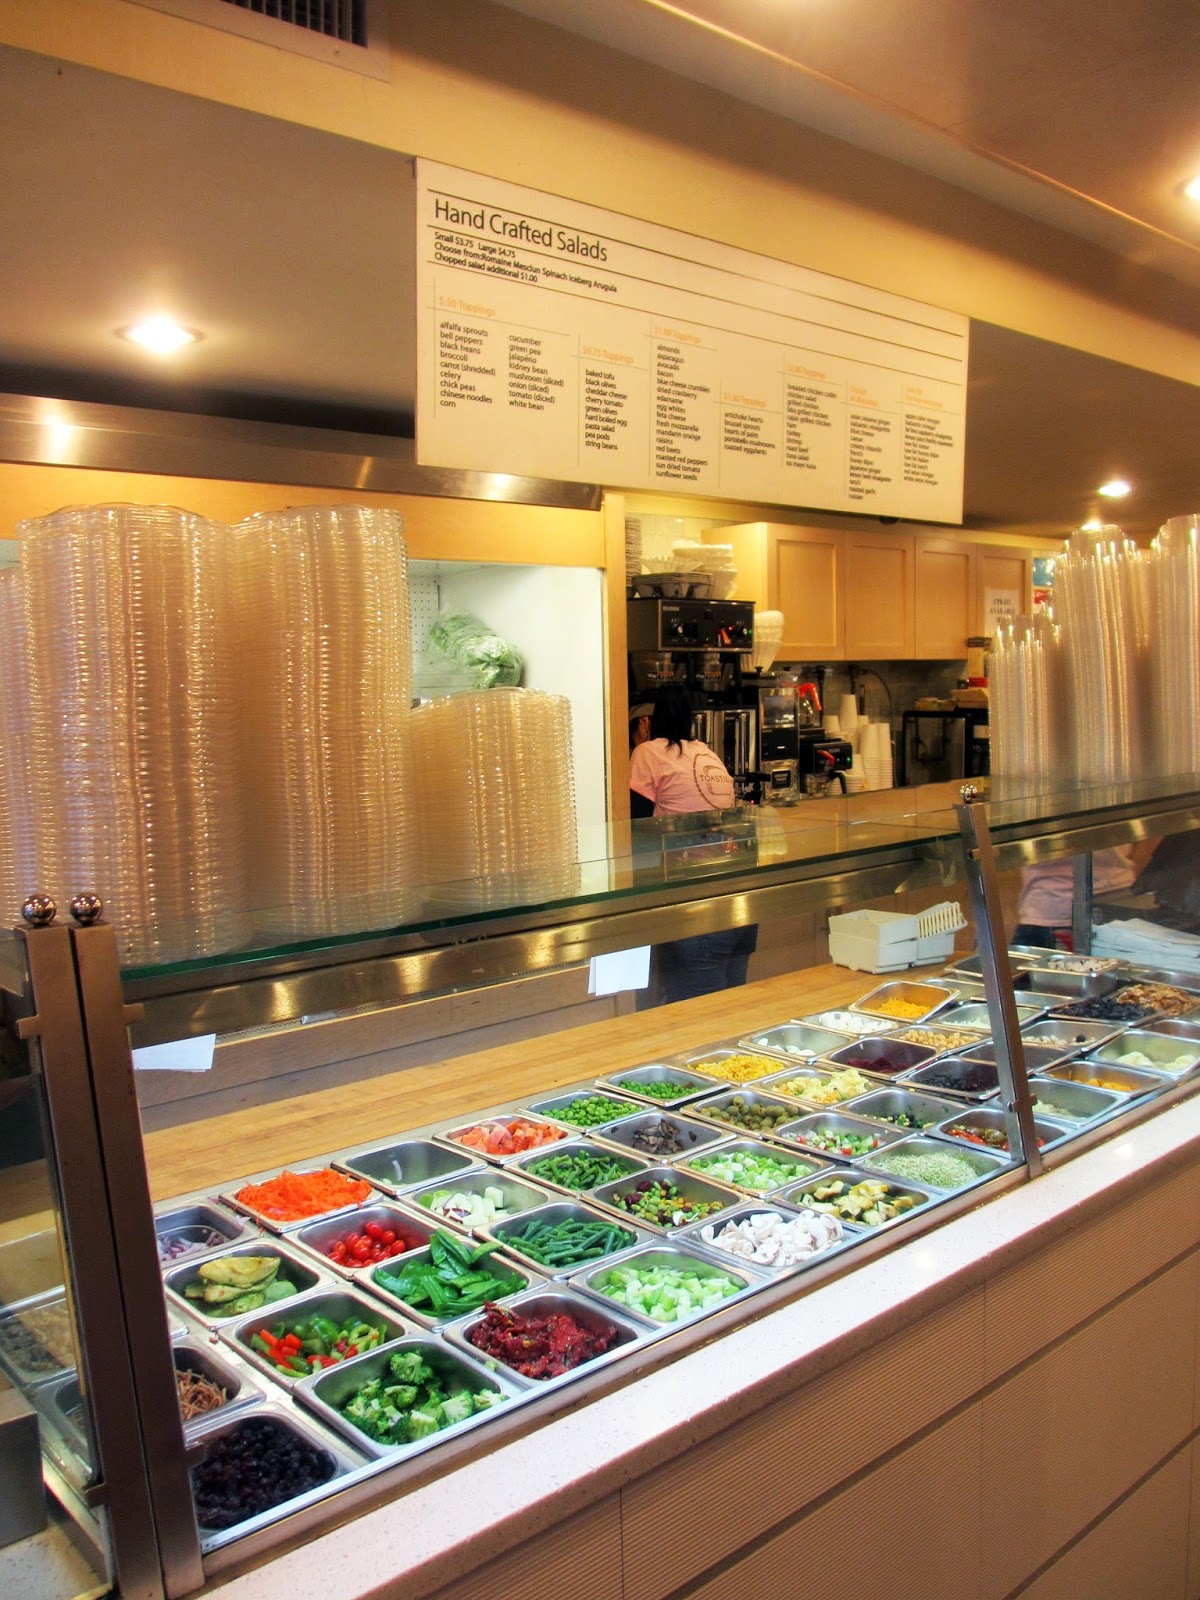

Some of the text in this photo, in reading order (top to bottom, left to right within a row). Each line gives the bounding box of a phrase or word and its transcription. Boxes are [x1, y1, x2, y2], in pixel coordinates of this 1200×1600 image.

[435, 198, 608, 261] Hand Crafted Salads
[434, 231, 516, 258] Small $3.75 Large $4.75
[434, 241, 462, 256] Choose
[542, 266, 568, 281] Spinach
[569, 274, 593, 288] Iceberg
[593, 280, 618, 293] Arugula
[434, 251, 538, 283] Chopped salad additional $1.00
[459, 299, 496, 318] Toppings
[440, 321, 488, 336] alfalfa sprouts
[440, 330, 483, 345] bell peppers
[509, 335, 541, 346] cucumber
[440, 340, 480, 354] black beans
[509, 344, 528, 352] green
[657, 344, 680, 354] almonds
[440, 350, 468, 361] broccoli
[602, 348, 635, 364] Toppings
[657, 353, 684, 363] asparagus
[440, 361, 495, 376] carrot (shredded)
[509, 360, 548, 374] kidney bean
[657, 362, 679, 370] avocado
[440, 370, 461, 381] celery
[586, 369, 614, 380] baked tofu
[657, 368, 673, 377] bacon
[440, 379, 475, 391] chick peas
[509, 372, 564, 387] mushroom (sliced)
[586, 377, 616, 389] black olives
[657, 377, 710, 393] blue cheese crumbles
[509, 381, 549, 394] onion (sliced)
[585, 386, 627, 399] cheddar cheese
[656, 386, 697, 400] dried cranberry
[440, 389, 492, 403] chinese noodles
[508, 390, 555, 403] tomato (diced)
[585, 395, 623, 407] cherry tomato
[657, 395, 683, 404] edamame
[509, 399, 544, 410] white bean
[656, 404, 685, 413] egg whites
[602, 407, 617, 415] olives
[656, 410, 686, 421] feta cheese
[585, 412, 627, 427] hard boiled egg
[724, 412, 763, 423] artichoke hearts
[724, 419, 742, 427] brussel
[601, 424, 615, 432] salad
[656, 419, 698, 432] fresh mozzarella
[724, 427, 740, 435] hearts
[656, 429, 701, 441] mandarin orange
[585, 440, 618, 450] string beans
[724, 436, 775, 448] portobello mushrooms
[666, 446, 681, 454] beets
[666, 462, 681, 470] dried
[682, 465, 700, 473] tomato
[656, 470, 682, 478] sunflower
